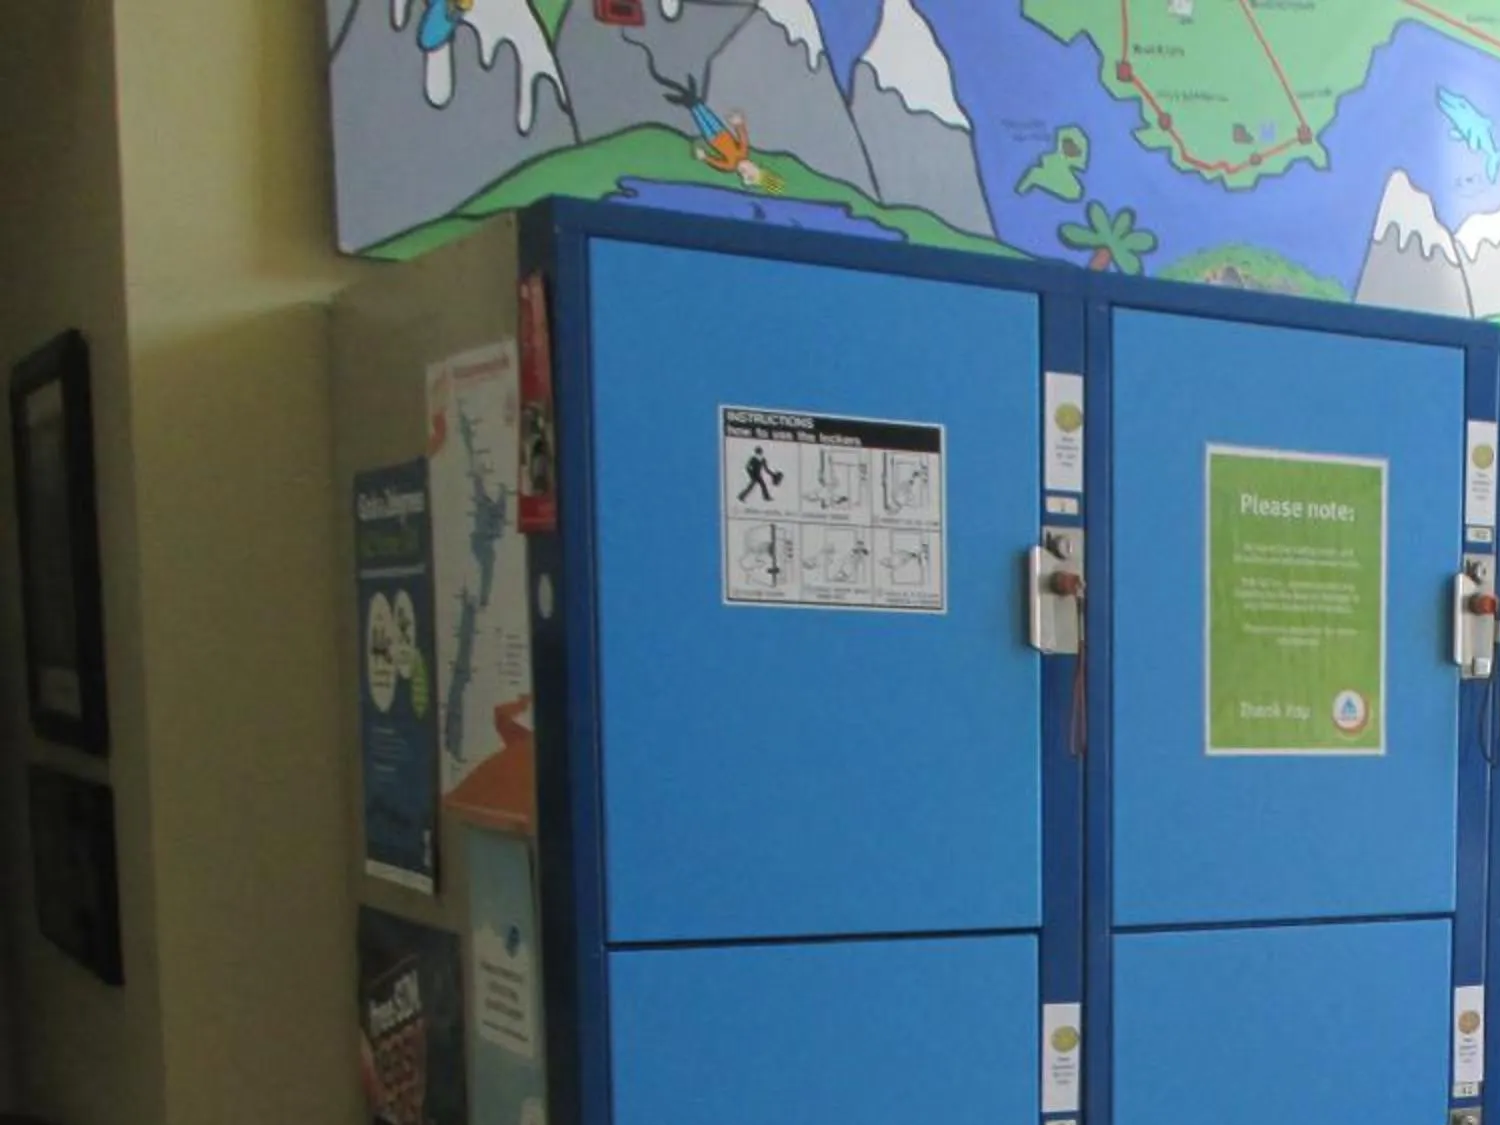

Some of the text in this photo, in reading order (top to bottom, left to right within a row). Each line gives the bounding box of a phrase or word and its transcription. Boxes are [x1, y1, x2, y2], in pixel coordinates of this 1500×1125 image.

[727, 411, 815, 430] INSTRUCTIONS
[727, 425, 752, 438] how
[755, 427, 768, 440] to
[1240, 493, 1356, 523] Please note:
